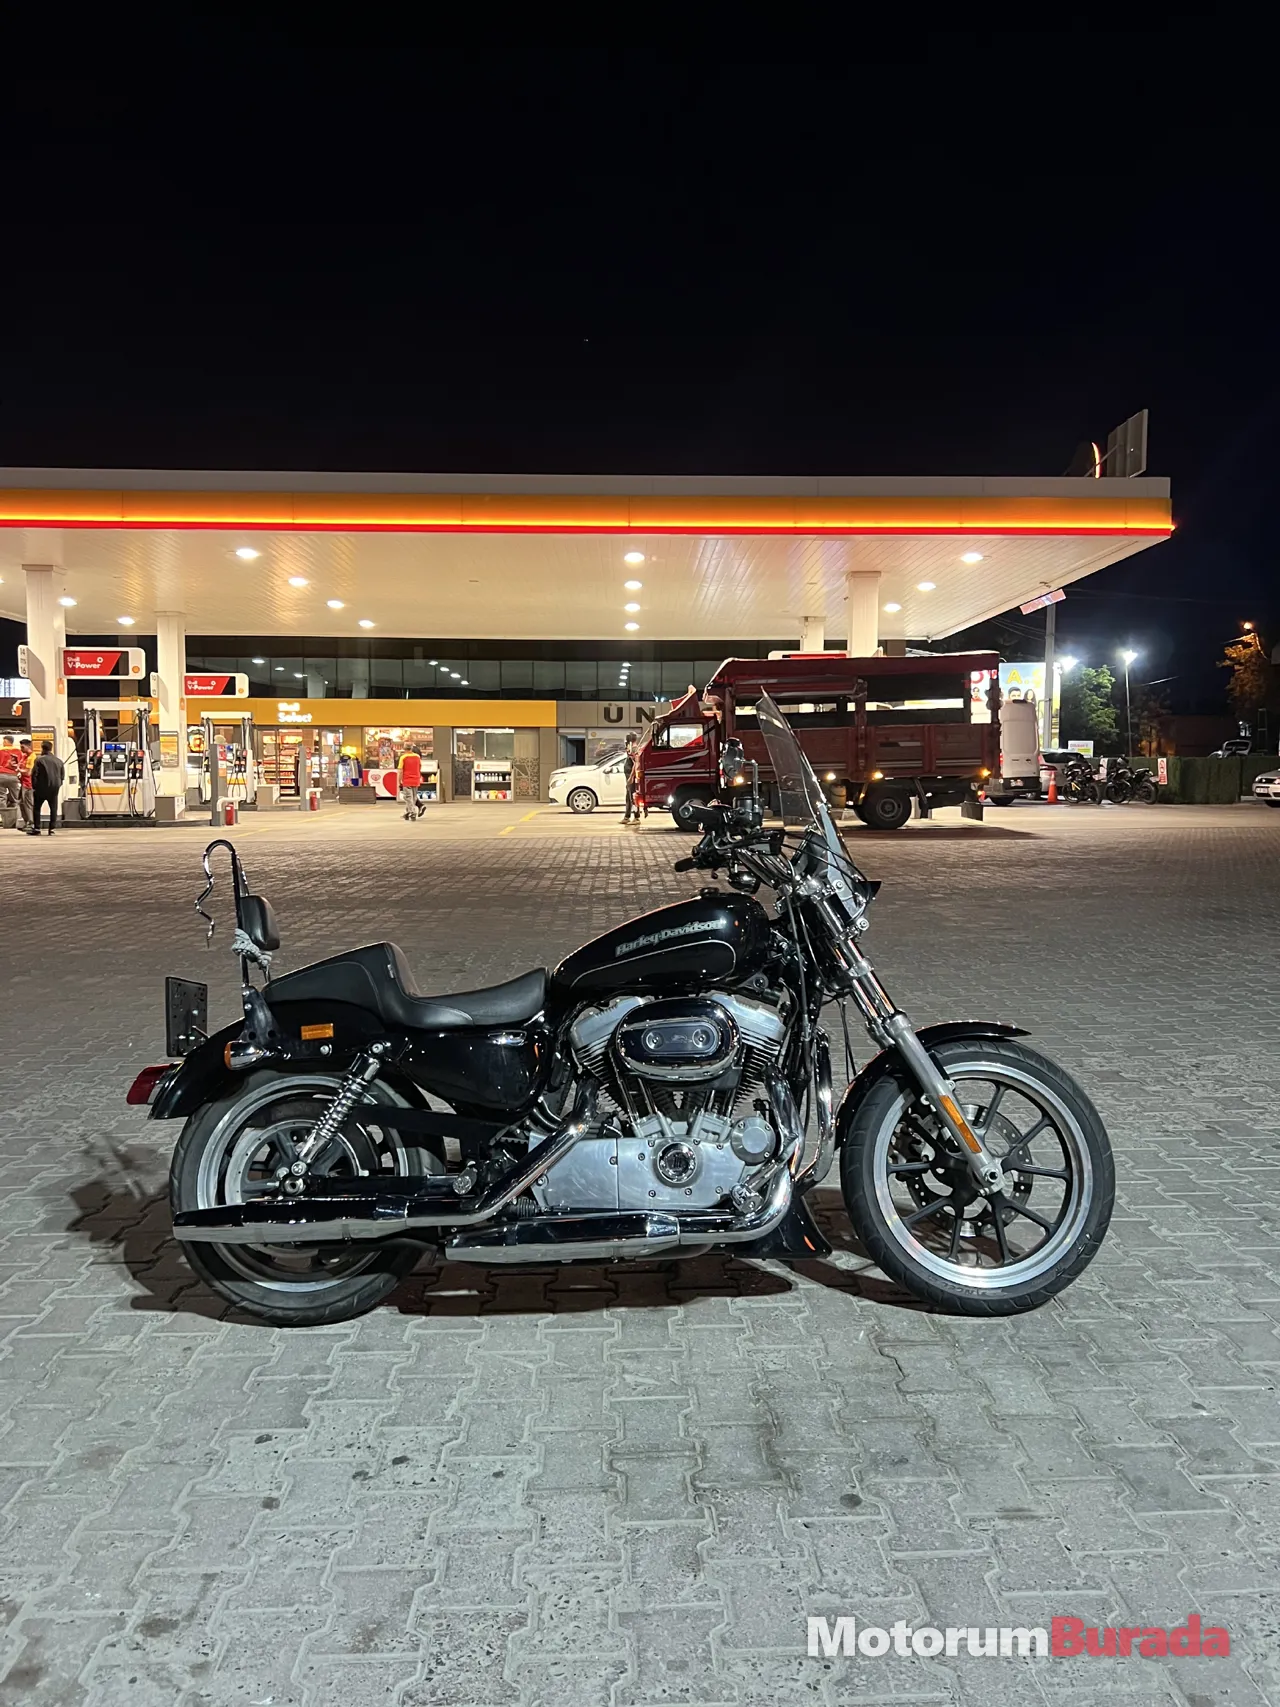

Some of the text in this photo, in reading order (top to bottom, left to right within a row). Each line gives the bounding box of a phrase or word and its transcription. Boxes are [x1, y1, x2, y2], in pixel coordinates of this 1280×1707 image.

[67, 661, 102, 669] V-Power
[277, 711, 313, 723] Select
[615, 918, 728, 957] Harley-Davidson
